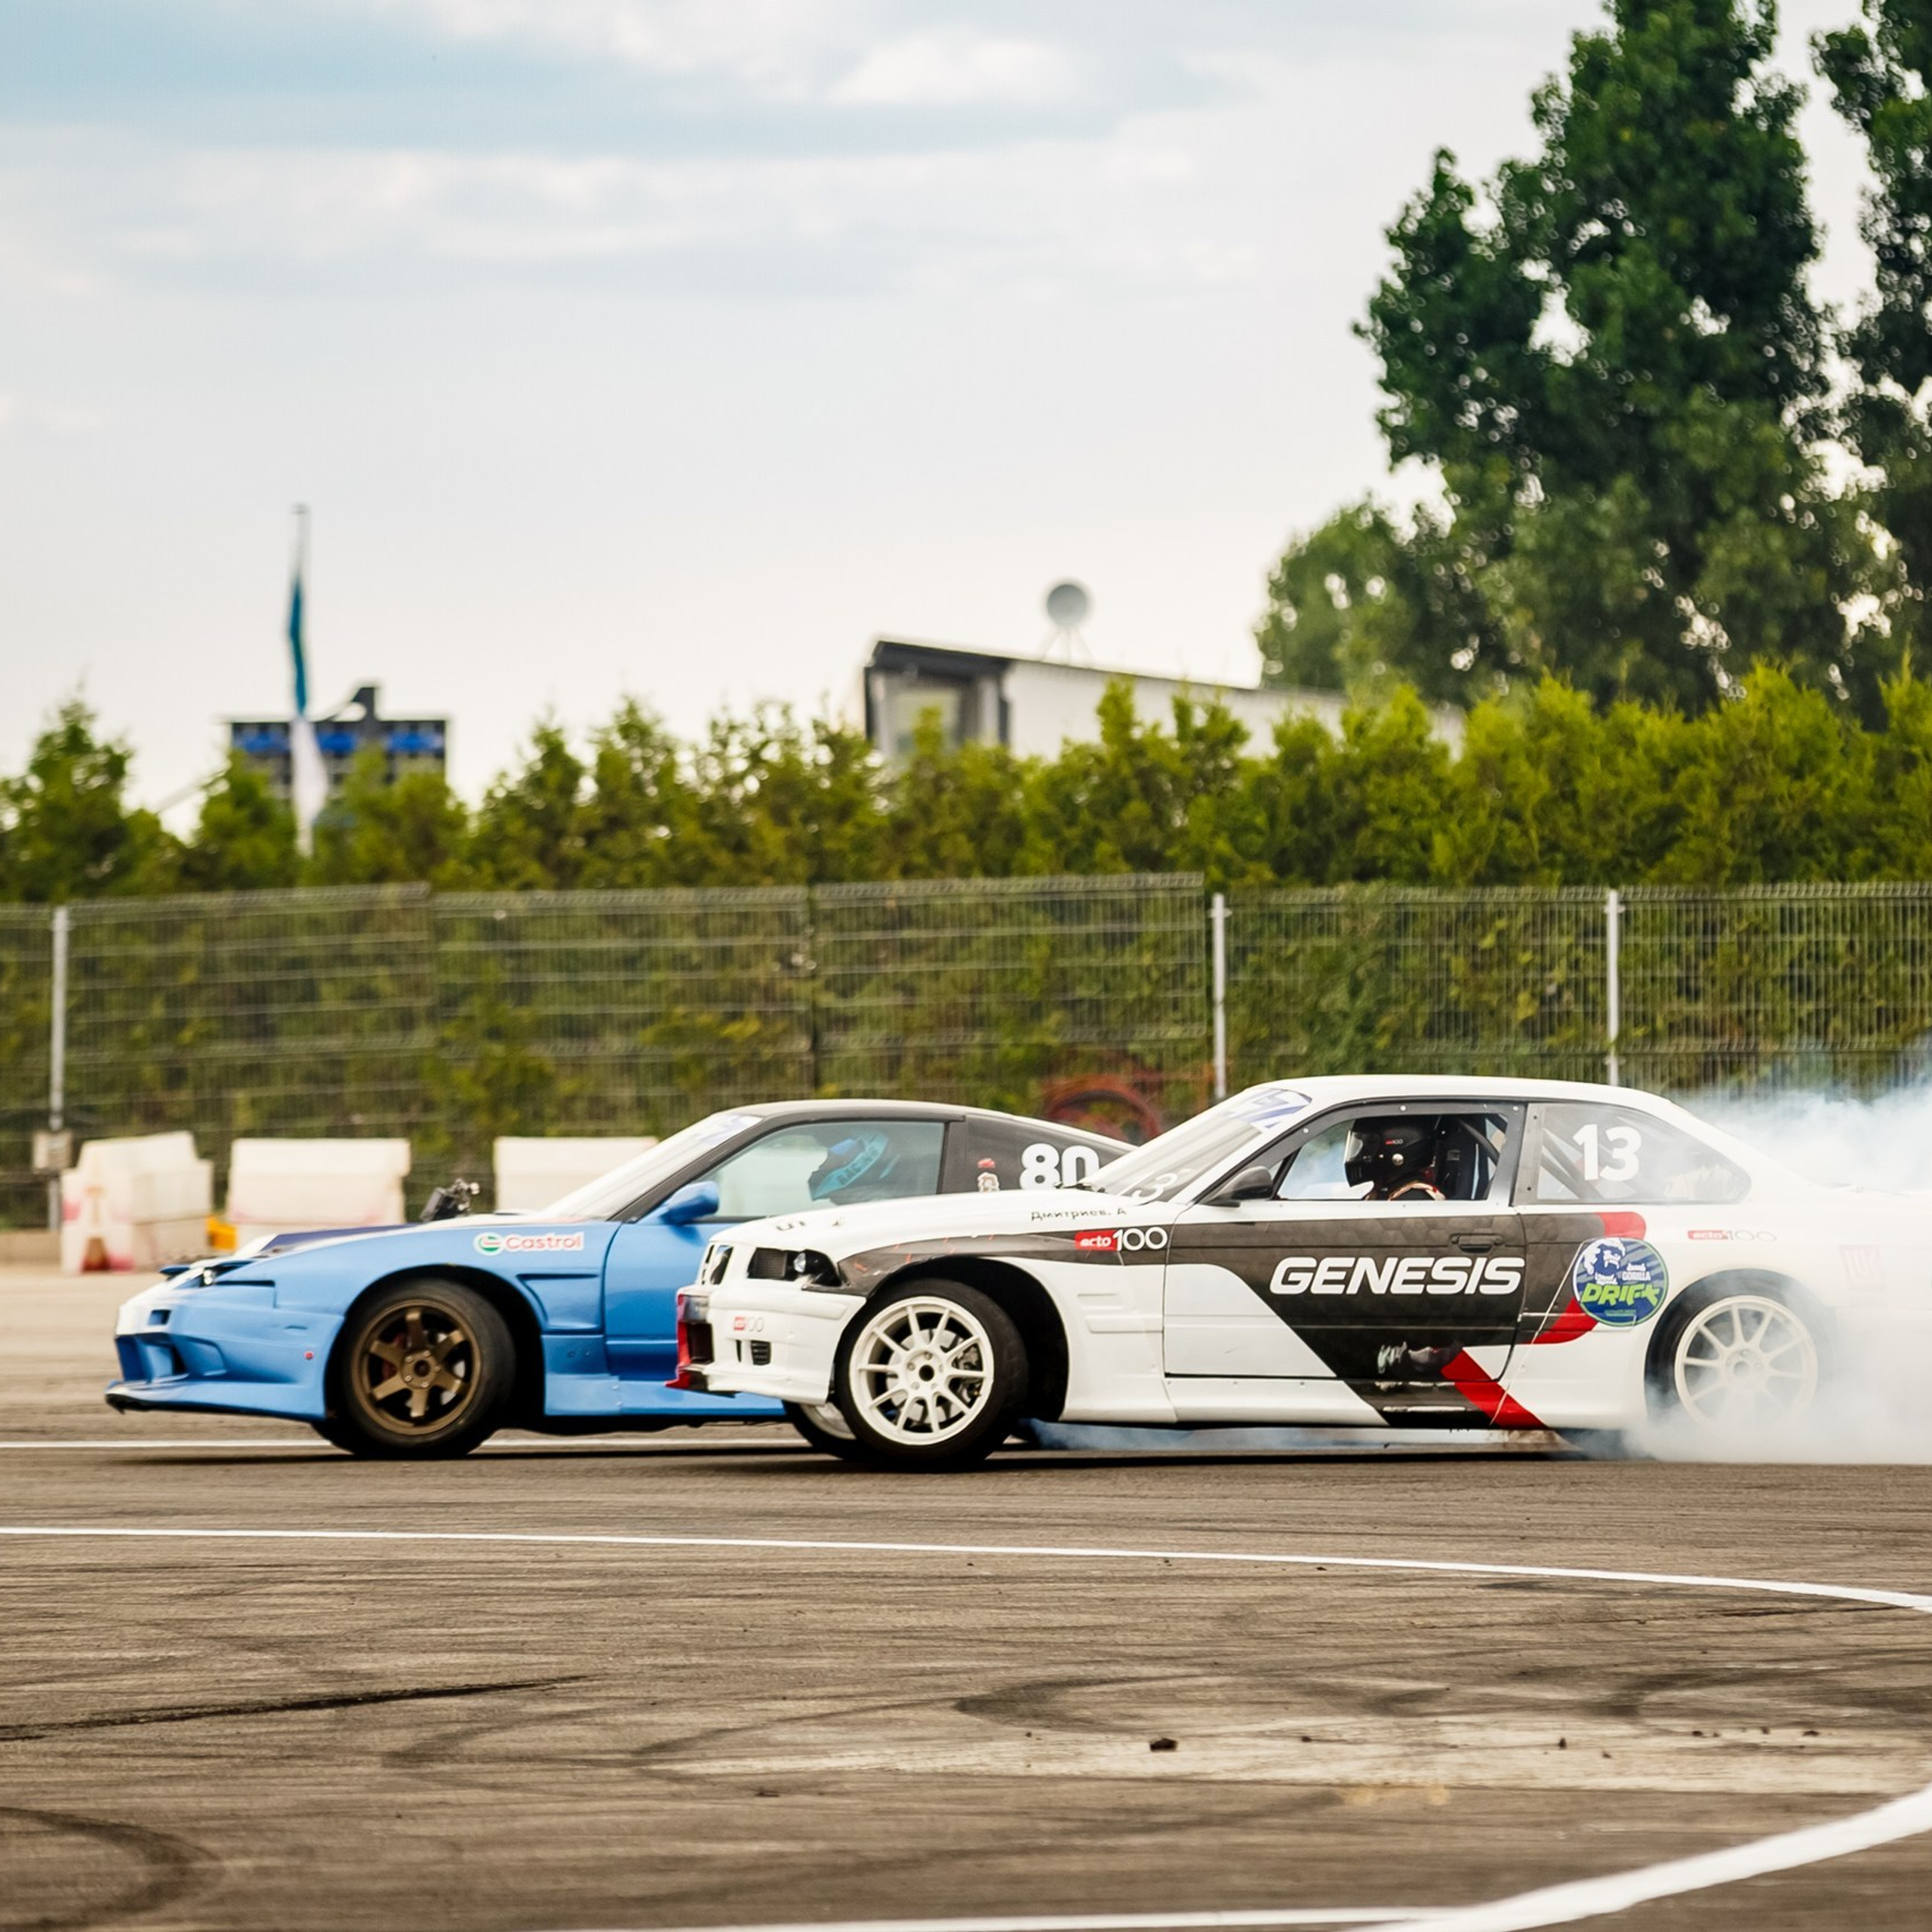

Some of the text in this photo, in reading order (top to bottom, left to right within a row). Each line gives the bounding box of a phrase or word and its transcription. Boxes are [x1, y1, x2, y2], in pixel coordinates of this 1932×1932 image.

[1020, 1142, 1100, 1190] 80
[1572, 1124, 1642, 1182] 13
[506, 1235, 582, 1250] Castrol
[1269, 1257, 1525, 1295] GENESIS
[1580, 1283, 1660, 1307] DRIFT
